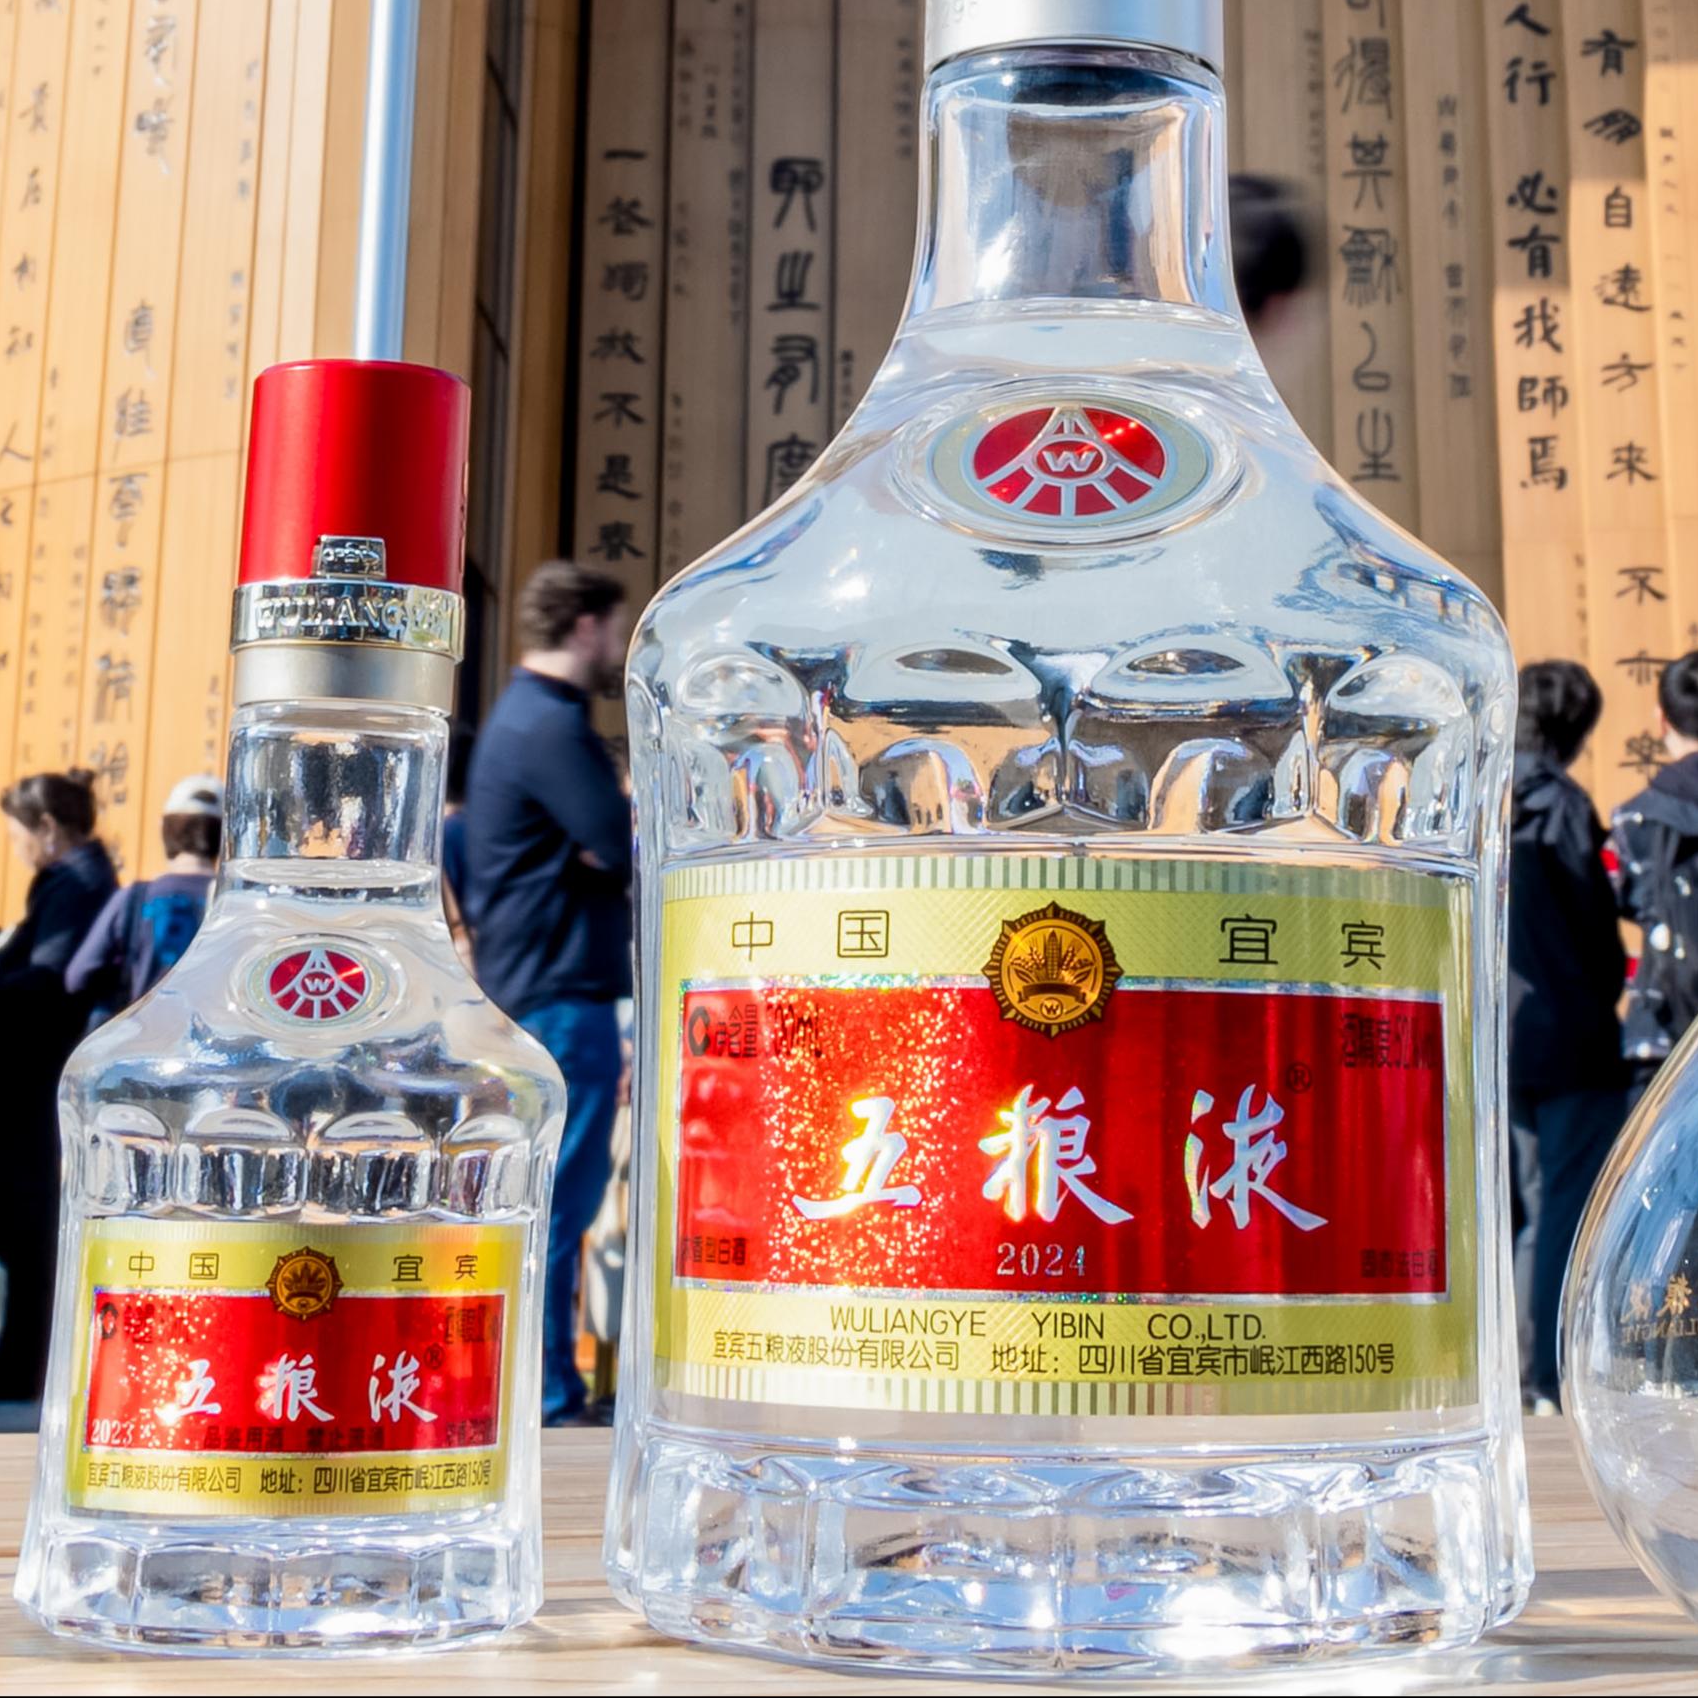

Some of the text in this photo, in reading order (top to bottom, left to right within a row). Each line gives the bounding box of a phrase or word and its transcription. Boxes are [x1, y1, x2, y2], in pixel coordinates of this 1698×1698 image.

[731, 910, 1387, 971] 中国 宜宾
[793, 1083, 1329, 1233] 五粮液
[127, 1251, 478, 1283] 中国 宜宾
[997, 1243, 1088, 1278] 2024
[830, 1307, 987, 1339] WULIANGYE
[1031, 1312, 1104, 1341] YIBIN
[712, 1329, 962, 1373] 宜宾五粮液股份有限公司
[175, 1350, 439, 1424] 五粮液
[91, 1418, 135, 1447] 2023
